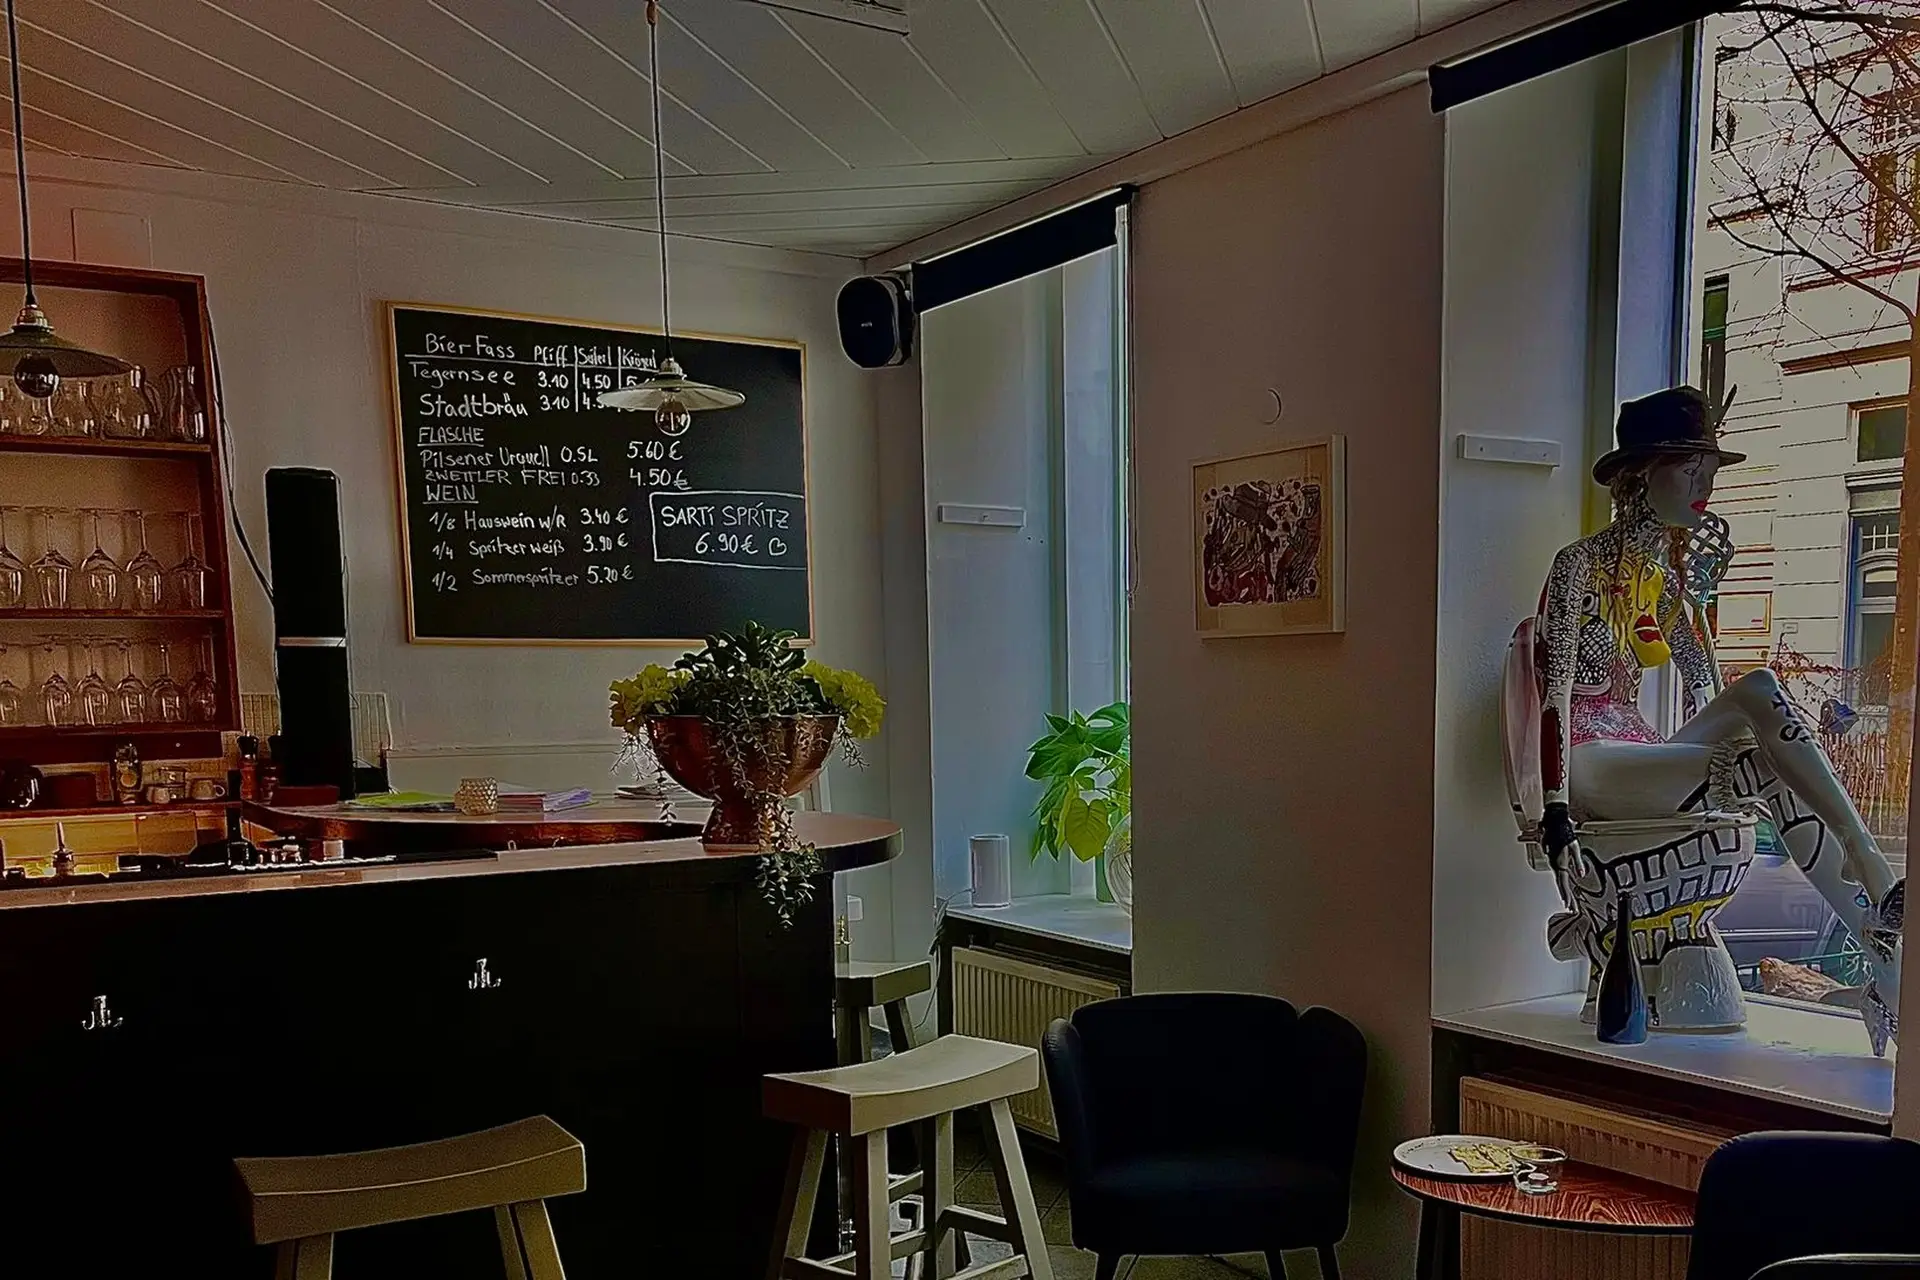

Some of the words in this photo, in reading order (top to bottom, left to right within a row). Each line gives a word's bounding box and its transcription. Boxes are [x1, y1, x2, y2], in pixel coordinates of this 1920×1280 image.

[425, 333, 472, 355] Bier
[476, 334, 516, 359] Fass
[534, 345, 569, 368] Pfiff
[408, 361, 516, 389] Tegernsee
[537, 370, 569, 389] 3.10
[582, 372, 611, 390] 4.50
[419, 393, 529, 418] Stadtbräu
[539, 394, 570, 412] 3.10
[418, 426, 484, 444] FLASCHE
[420, 449, 494, 468] Pilsener
[560, 445, 599, 463] 0.5L
[626, 440, 664, 460] 5.60
[668, 440, 684, 460] €
[425, 469, 513, 486] ZWETTLER
[520, 469, 566, 486] FREI
[570, 470, 600, 486] 0.33
[426, 483, 476, 501] WEIN
[429, 510, 456, 533] 1/8
[464, 509, 535, 532] Hauswein
[580, 507, 611, 525] 3.40
[615, 507, 629, 524] €
[432, 541, 454, 560] 1/4
[469, 536, 527, 559] Spritzer
[529, 538, 565, 557] weiß
[582, 533, 613, 553] 3.90
[617, 532, 629, 548] €
[432, 570, 458, 592] 1/2
[472, 566, 580, 588] Sommerspritzer
[586, 565, 619, 585] 5.20
[622, 564, 634, 580] €
